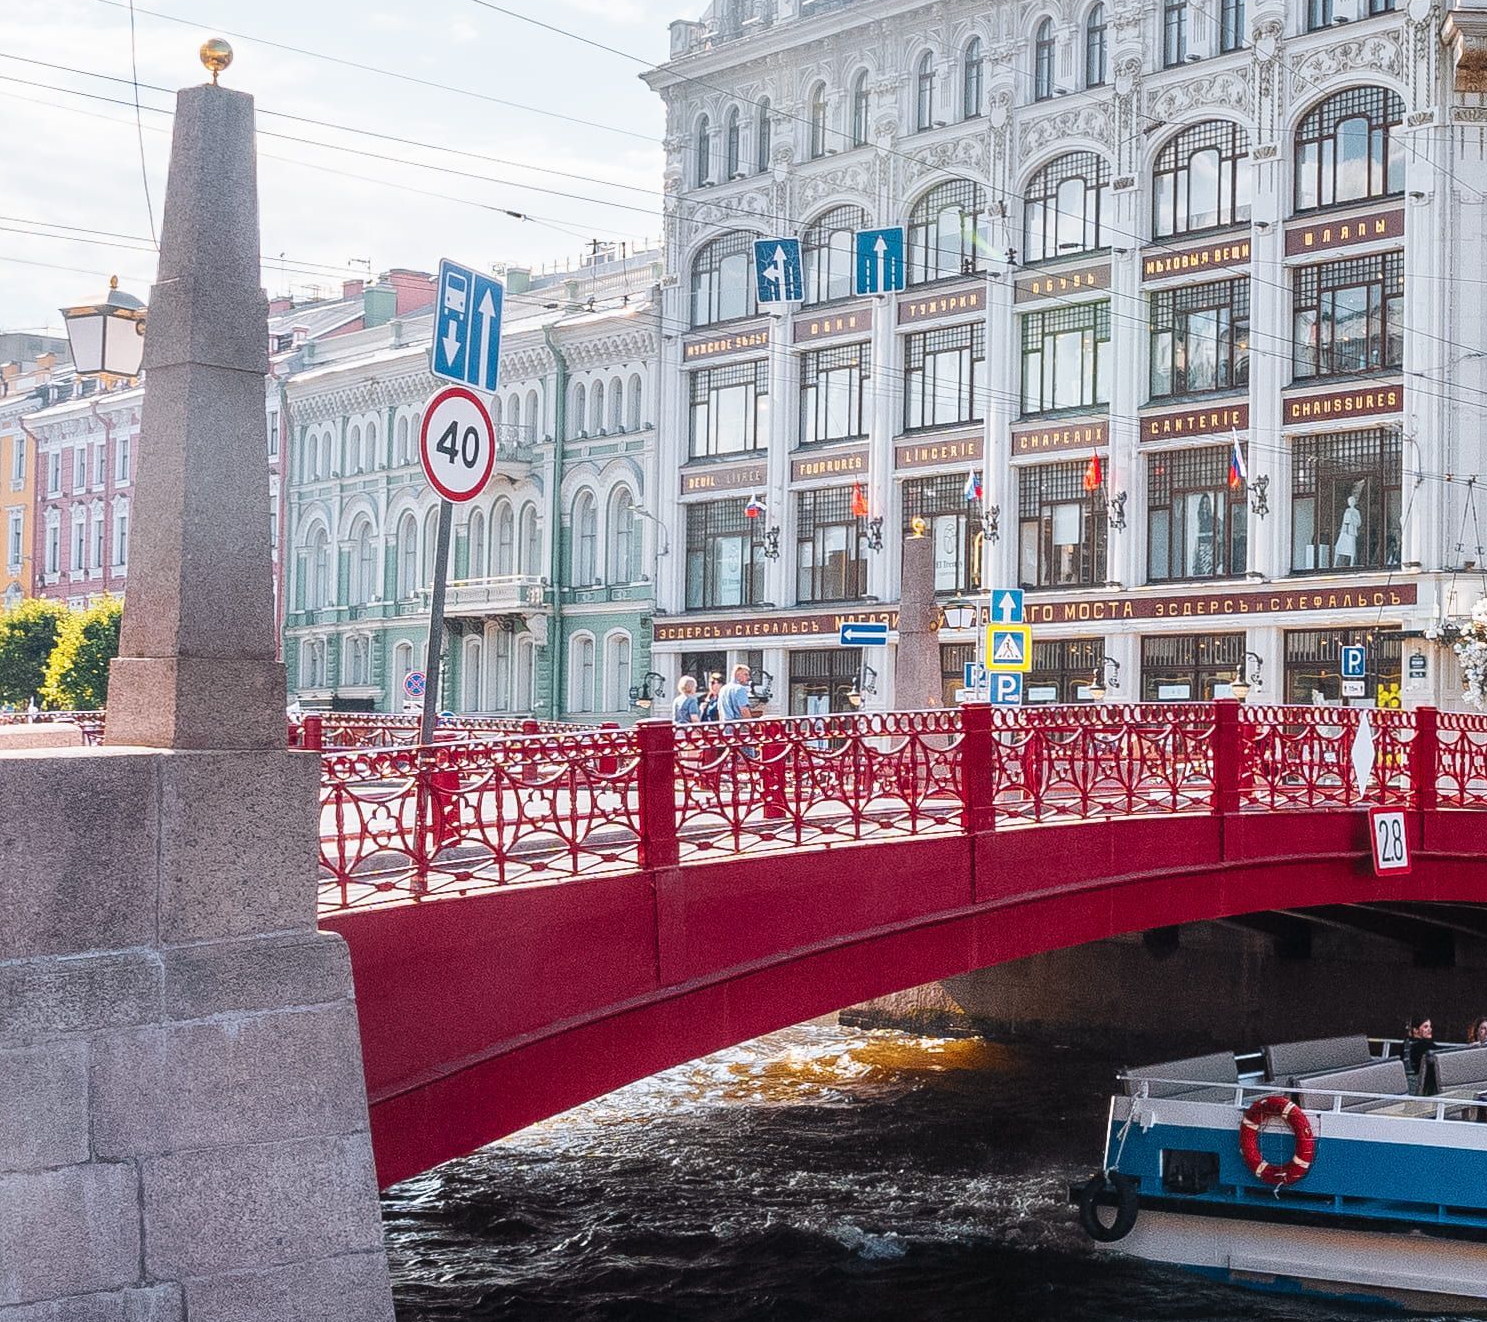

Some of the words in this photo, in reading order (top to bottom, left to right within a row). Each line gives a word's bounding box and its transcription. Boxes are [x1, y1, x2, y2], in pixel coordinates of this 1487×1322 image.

[1304, 219, 1386, 245] ШЛЯПЫ
[1214, 242, 1251, 263] ВЕЩИ
[1032, 272, 1096, 294] ОБУВЬ
[910, 294, 977, 317] ТУЖУРКИ
[1292, 391, 1396, 418] CHAUSSURES
[436, 420, 480, 469] 40
[1020, 428, 1103, 449] CHAPEAUX
[906, 441, 975, 464] LINGERIE
[800, 456, 862, 476] FOURRURES
[689, 476, 715, 489] DEUIL
[1155, 599, 1249, 615] ЭСДЕРСЪ
[1270, 592, 1401, 611] СХЕФАЛЬСЪ
[659, 626, 721, 639] ЭСДЕРСЪ
[735, 621, 819, 636] СХЕФАЛЬСЪ
[1064, 601, 1133, 620] МОСТА
[1349, 650, 1361, 673] P
[998, 675, 1016, 702] P
[1379, 819, 1403, 862] 2.8
